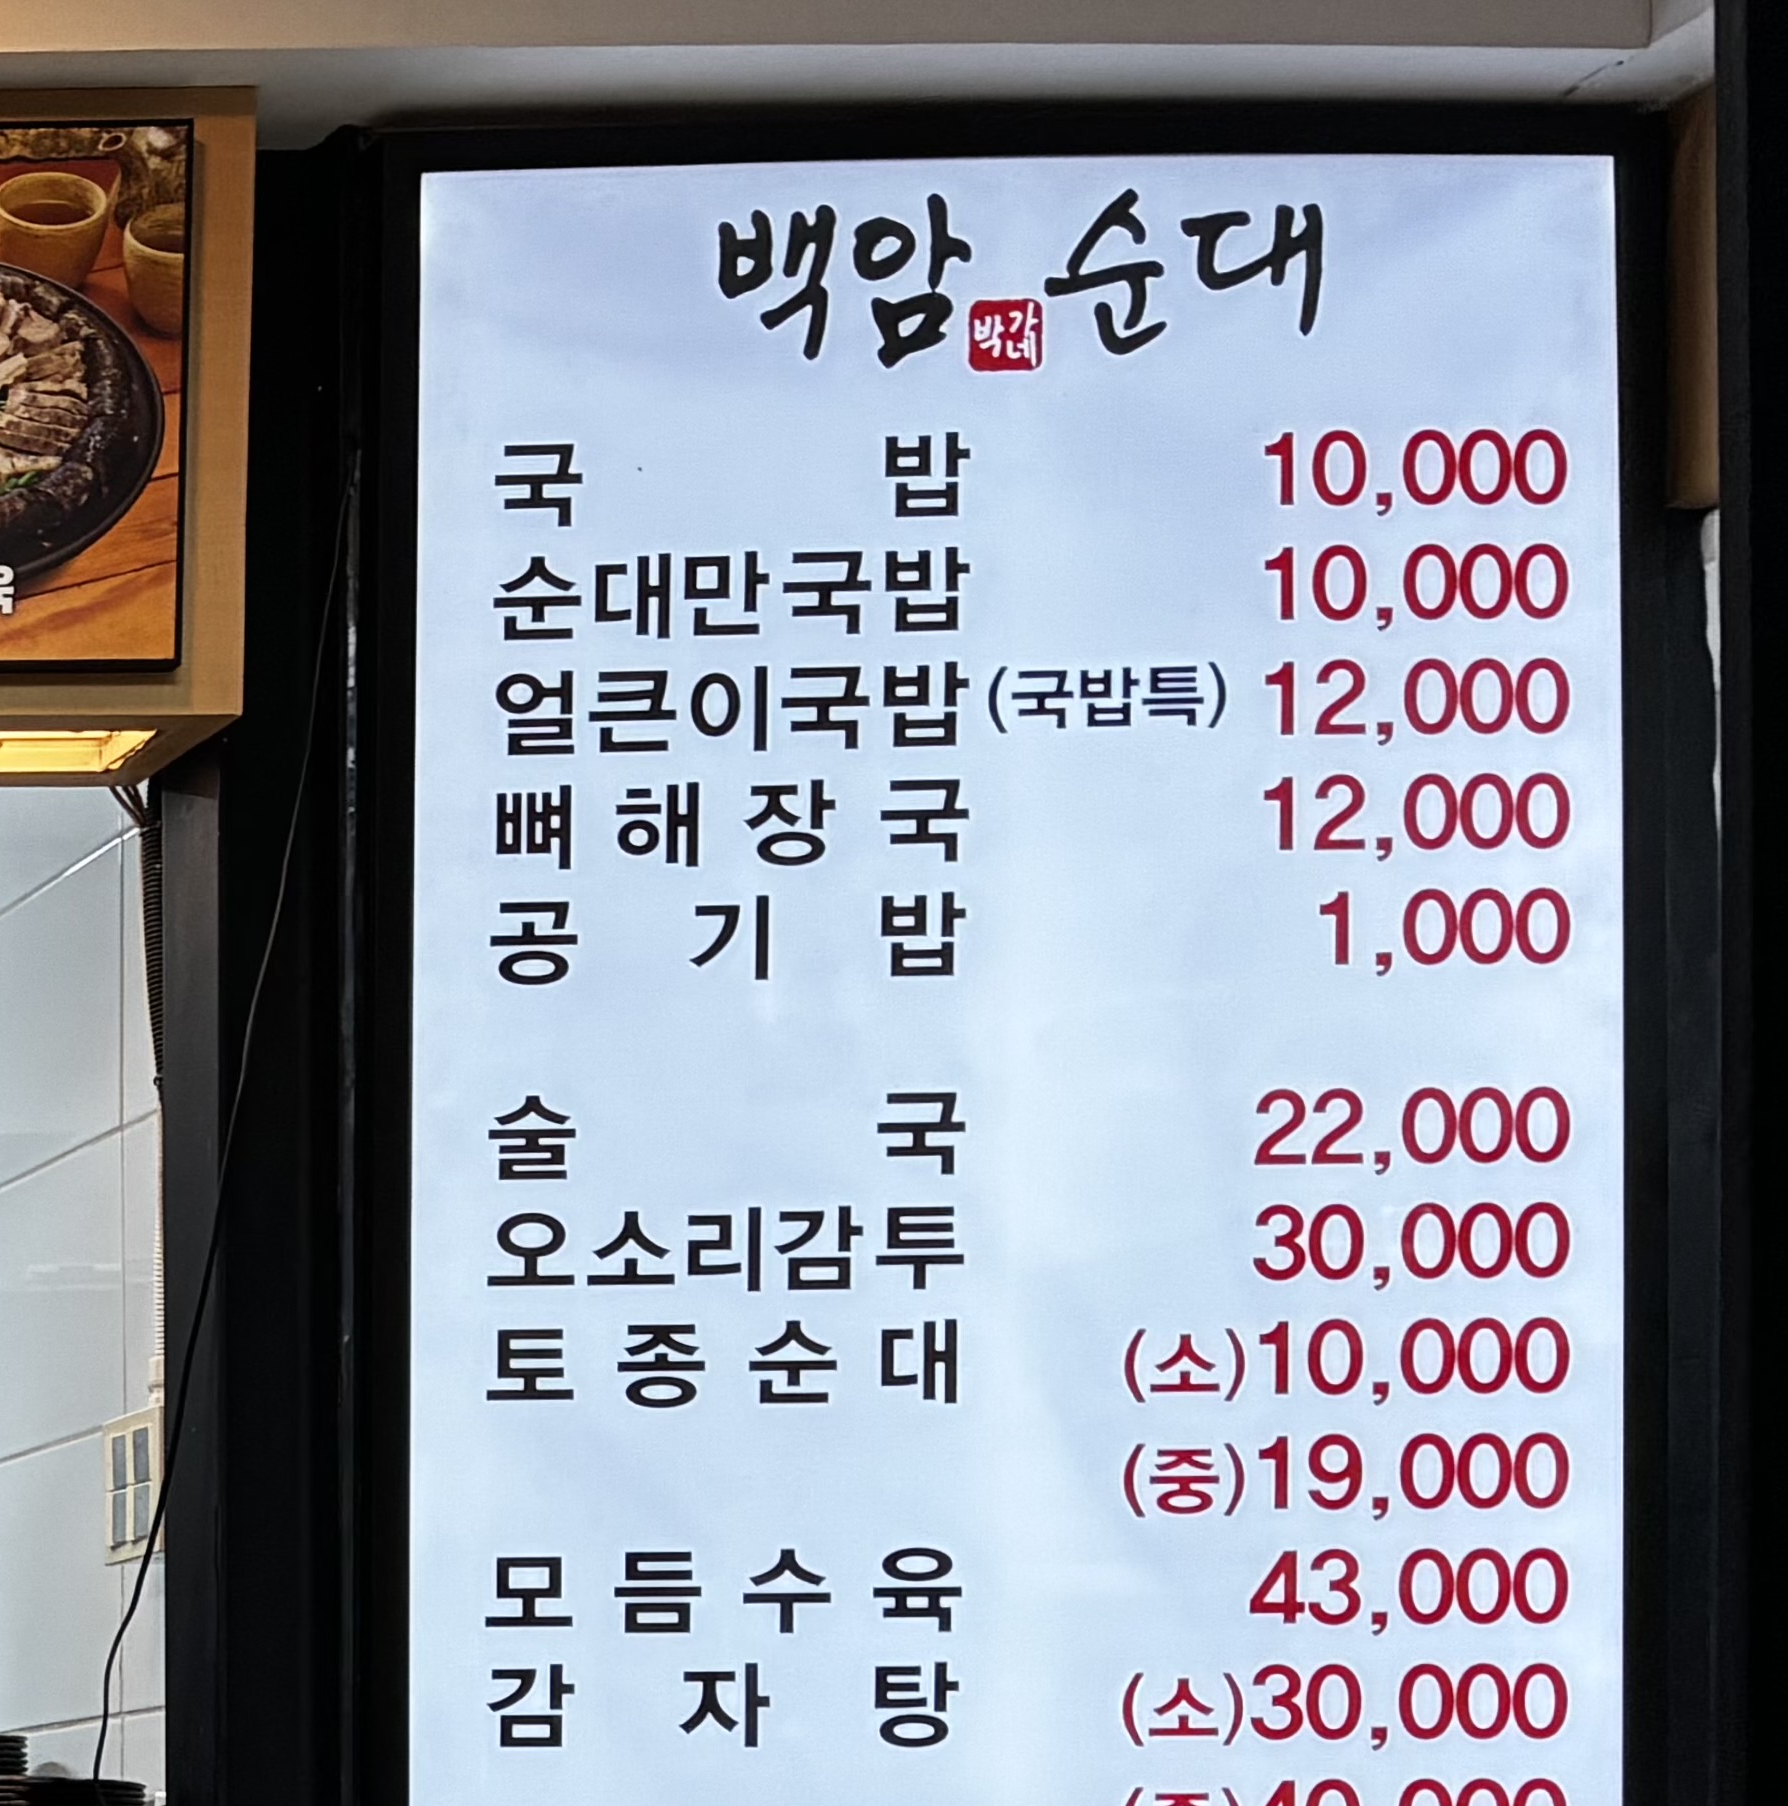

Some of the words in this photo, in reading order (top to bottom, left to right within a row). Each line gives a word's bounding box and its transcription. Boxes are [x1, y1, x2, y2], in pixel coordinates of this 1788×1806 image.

[717, 193, 972, 369] 백암
[1043, 188, 1324, 356] 순대
[1264, 428, 1568, 517] 10,000
[493, 546, 971, 641] 순대만국밥
[1264, 543, 1569, 632] 10,000
[495, 661, 970, 756] 얼큰이국밥
[988, 661, 1227, 734] (국밥특)
[1265, 657, 1570, 746] 12,000
[1263, 772, 1570, 862] 12,000
[1319, 887, 1571, 977] 1,000
[1254, 1086, 1570, 1176] 22,000
[486, 1205, 965, 1292] 오소리감투
[1253, 1201, 1570, 1291] 30,000
[1249, 1547, 1569, 1636] 43,000
